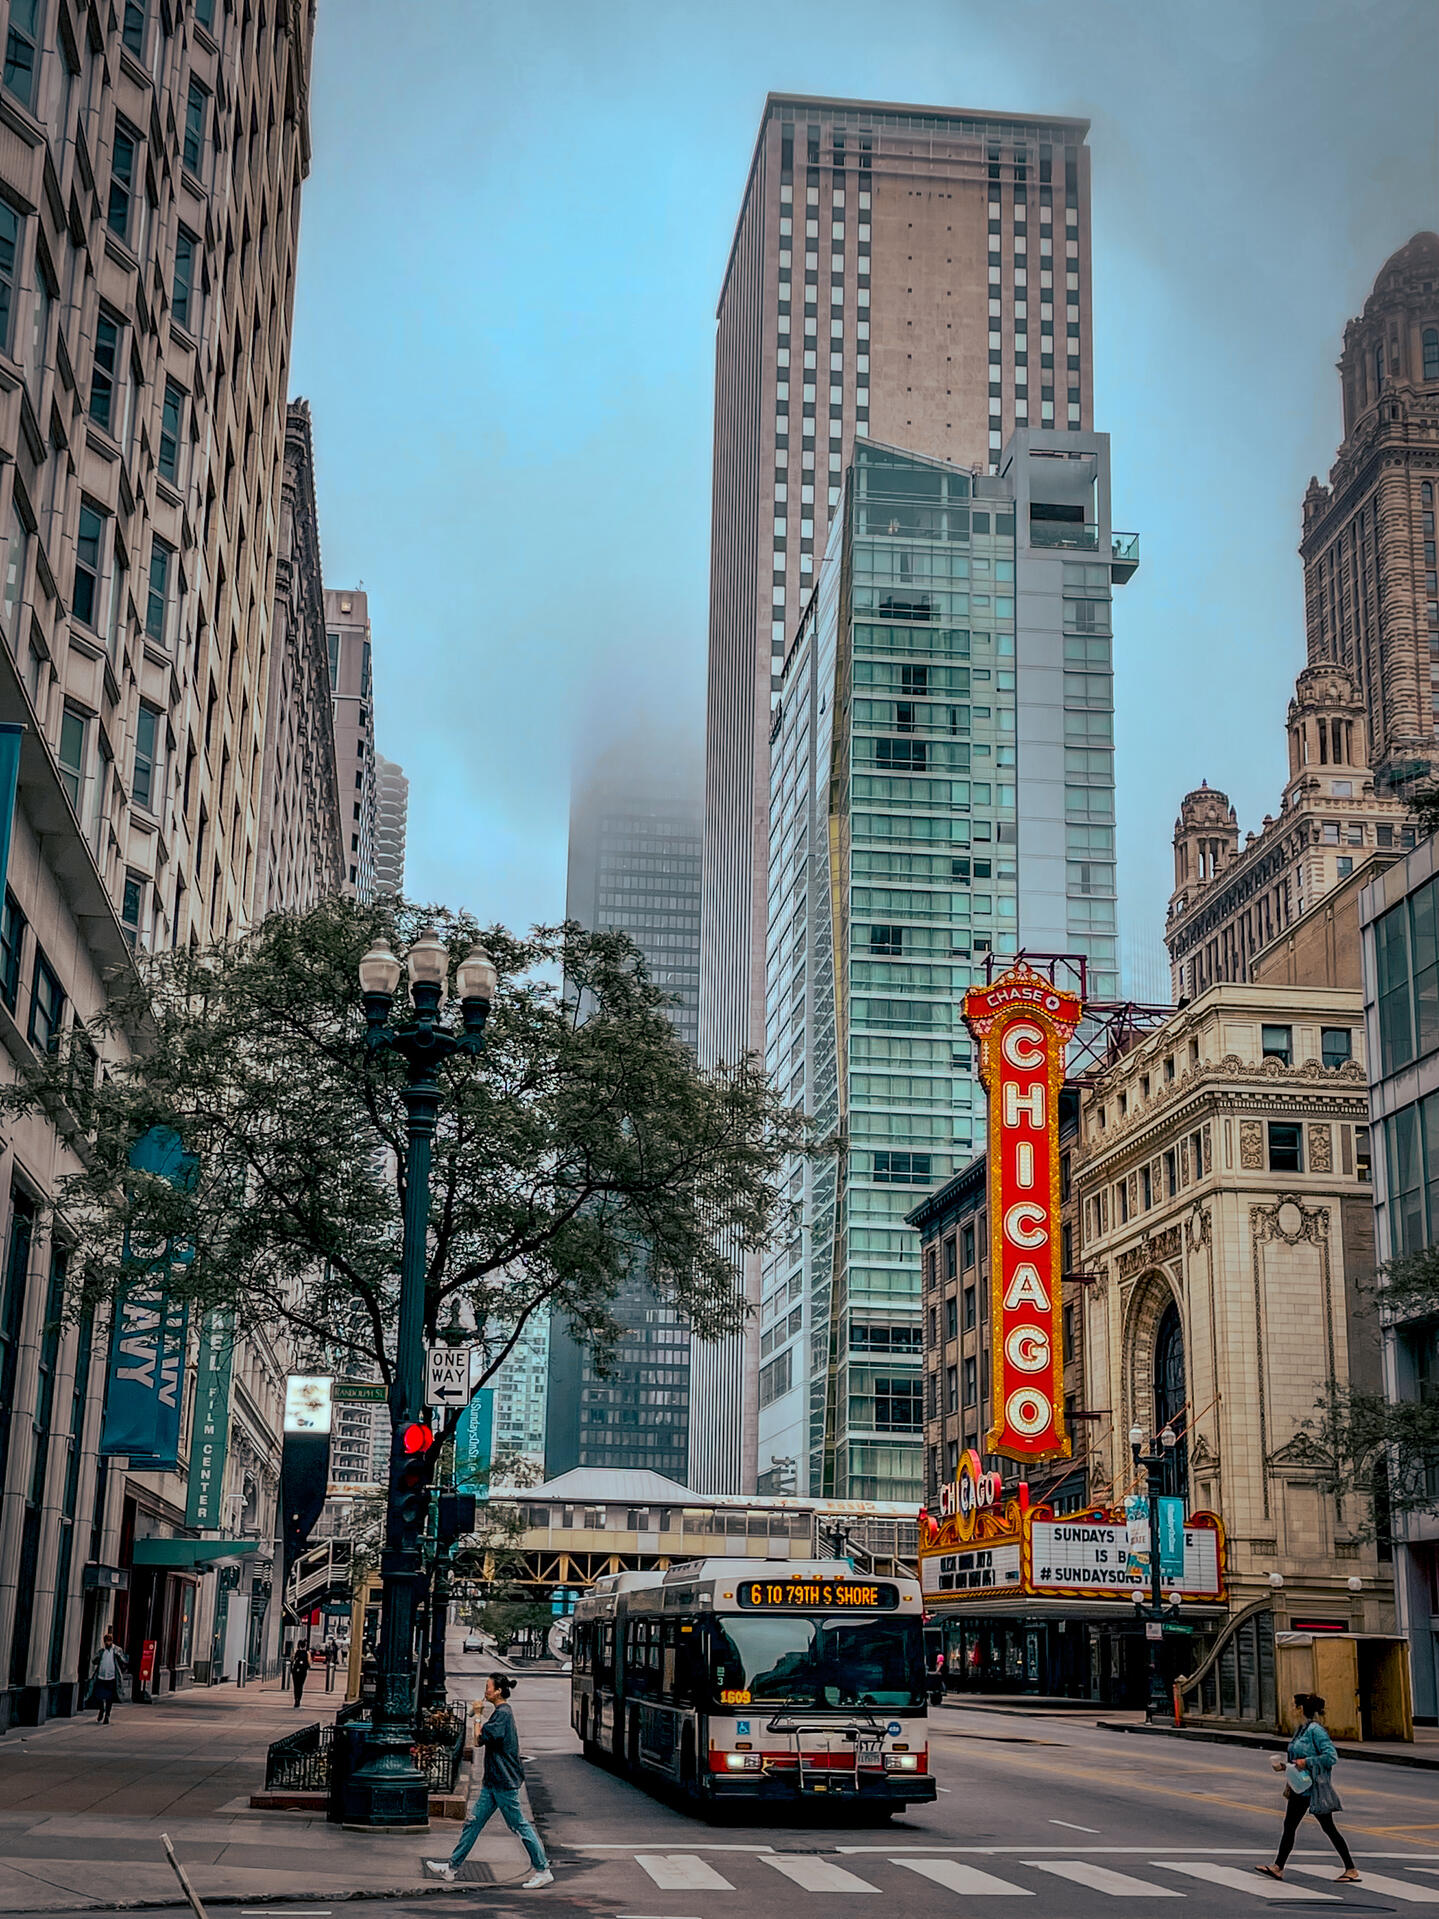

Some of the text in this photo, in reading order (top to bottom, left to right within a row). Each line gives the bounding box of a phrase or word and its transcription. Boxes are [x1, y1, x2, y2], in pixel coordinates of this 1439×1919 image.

[987, 988, 1044, 1007] CHASE
[1002, 1024, 1053, 1437] CHICAGO
[433, 1353, 465, 1367] ONE
[432, 1369, 465, 1383] WAY
[198, 1314, 224, 1517] KEL FILM CENTER
[467, 1398, 482, 1472] #SundaysOnStte
[940, 1471, 995, 1515] CHICAGO
[1054, 1528, 1115, 1543] SUNDAYS
[1096, 1550, 1108, 1562] IS
[751, 1584, 878, 1605] 6 TO 79TH S SHORE
[717, 1677, 724, 1686] 3
